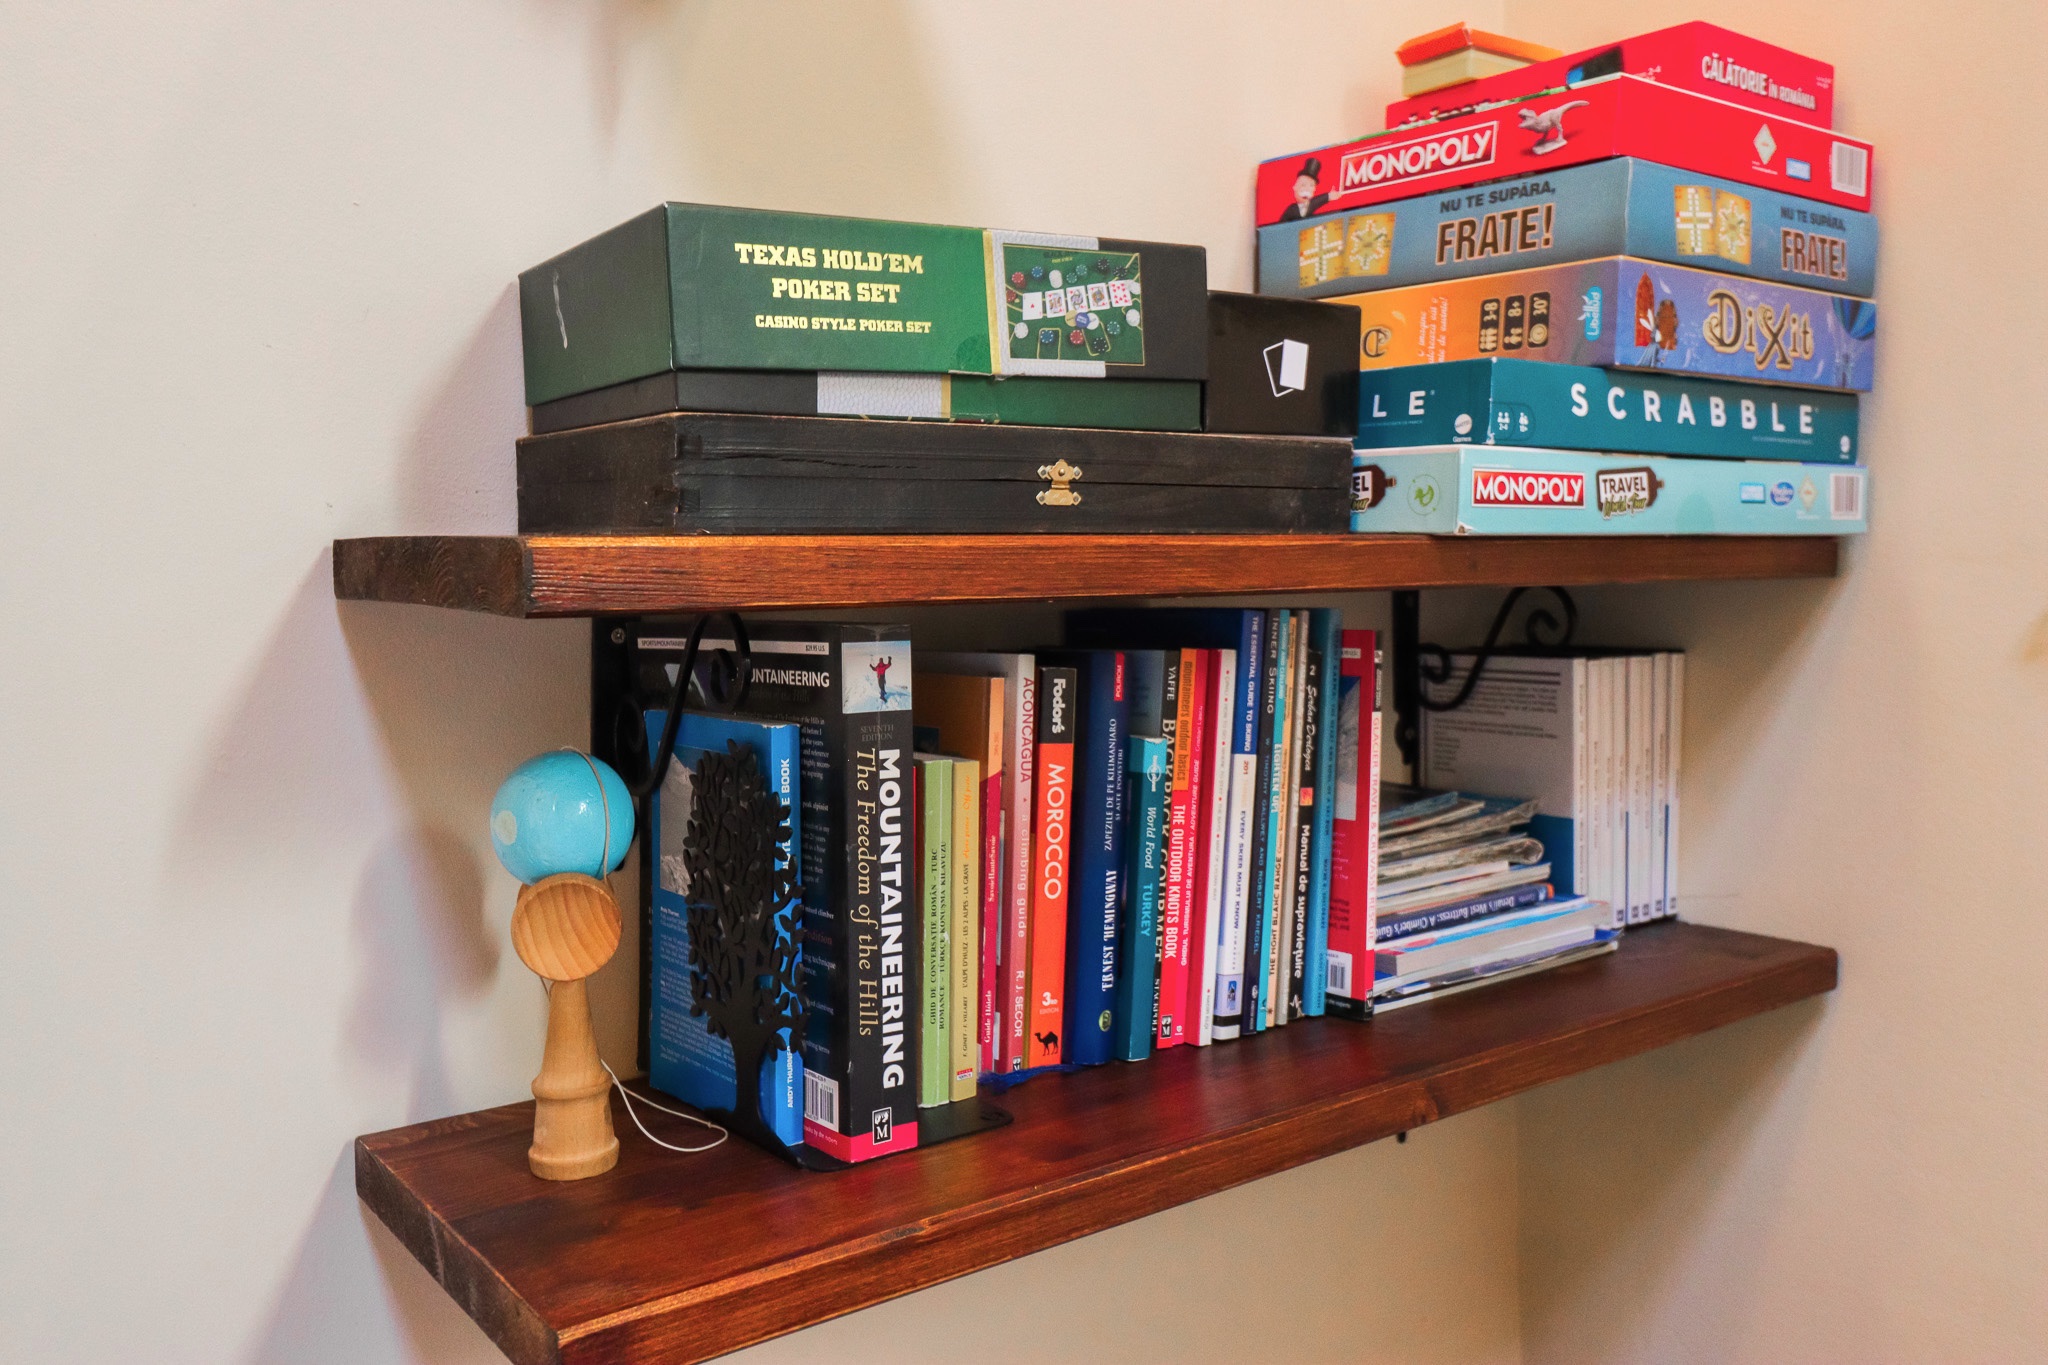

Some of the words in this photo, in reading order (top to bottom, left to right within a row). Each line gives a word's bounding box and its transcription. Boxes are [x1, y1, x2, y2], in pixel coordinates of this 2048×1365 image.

[1701, 52, 1768, 96] CĂLĂTORIE
[1345, 129, 1492, 187] MONOPOLY
[1439, 197, 1461, 214] NU
[1465, 193, 1485, 209] TE
[1435, 203, 1556, 266] FRATE!
[734, 242, 817, 268] TEXAS
[822, 248, 924, 275] HOLD'EM
[1780, 227, 1847, 281] FRATE!
[771, 277, 852, 301] POKER
[856, 281, 900, 304] SET
[755, 314, 808, 330] CASINO
[811, 316, 857, 331] STYLE
[859, 318, 904, 333] POKER
[906, 321, 932, 334] SET
[1482, 300, 1499, 322] 3-8
[1507, 301, 1522, 318] 8+
[1584, 291, 1601, 336] Libellud
[1570, 382, 1814, 435] SCRABBLE
[1476, 475, 1582, 503] MONOPOLY
[1601, 476, 1646, 495] TRAVEL
[1270, 617, 1279, 658] INNER
[1249, 634, 1257, 679] ESSENTIAL
[751, 668, 830, 688] UNTAINEERING
[1166, 666, 1177, 700] YAFFE
[1181, 661, 1194, 717] mountaineers
[1247, 681, 1255, 707] GUIDE
[1266, 667, 1278, 714] SKIING
[1052, 678, 1067, 734] Fodor's
[1246, 709, 1253, 722] TO
[860, 724, 894, 733] SEVENTH
[862, 732, 893, 741] EDITION
[1021, 677, 1034, 783] ACONCAGUA
[1179, 720, 1190, 751] outdoor
[1372, 717, 1380, 768] GLACIER
[1107, 719, 1117, 781] KILIMANJARO
[1303, 724, 1315, 771] Derlogea
[781, 758, 790, 794] BOOK
[857, 748, 877, 791] The
[1177, 754, 1189, 780] basics
[1271, 743, 1282, 792] LIGHTEN
[1105, 796, 1114, 808] DE
[1106, 784, 1115, 794] PE
[1371, 774, 1379, 817] TRAVEL
[1044, 764, 1066, 900] MOROCCO
[1145, 807, 1157, 838] World
[1173, 805, 1186, 825] THE
[857, 800, 877, 895] Freedom
[1017, 829, 1029, 890] climbing
[1144, 841, 1155, 869] Food
[1170, 828, 1184, 882] OUTDOOR
[1300, 825, 1310, 871] Manual
[1369, 833, 1377, 891] CREVASSE
[929, 884, 938, 917] ROMÂN
[962, 886, 969, 895] LA
[1235, 871, 1243, 898] MUST
[1300, 875, 1308, 892] de
[850, 904, 879, 929] of
[879, 749, 905, 1088] MOUNTAINEERING
[1017, 898, 1027, 938] guide
[1103, 870, 1117, 941] HEMINGWAY
[1141, 883, 1153, 936] TURKEY
[1167, 885, 1180, 923] KNOTS
[1368, 897, 1376, 941] RESCUE
[1436, 907, 1469, 922] Buttress:
[1469, 903, 1487, 916] West
[1488, 895, 1514, 912] Denali's
[1292, 896, 1306, 978] supraviețuire
[1394, 916, 1428, 933] Climber's
[1428, 916, 1435, 926] A
[858, 934, 878, 969] the
[1165, 927, 1179, 959] BOOK
[1015, 970, 1025, 981] R.
[1101, 946, 1114, 992] ERNEST
[929, 986, 937, 998] DE
[984, 990, 992, 1016] Hôtels
[1015, 985, 1024, 993] J.
[859, 979, 879, 1036] Hills
[929, 1002, 937, 1025] GHID
[1014, 996, 1024, 1037] SECOR
